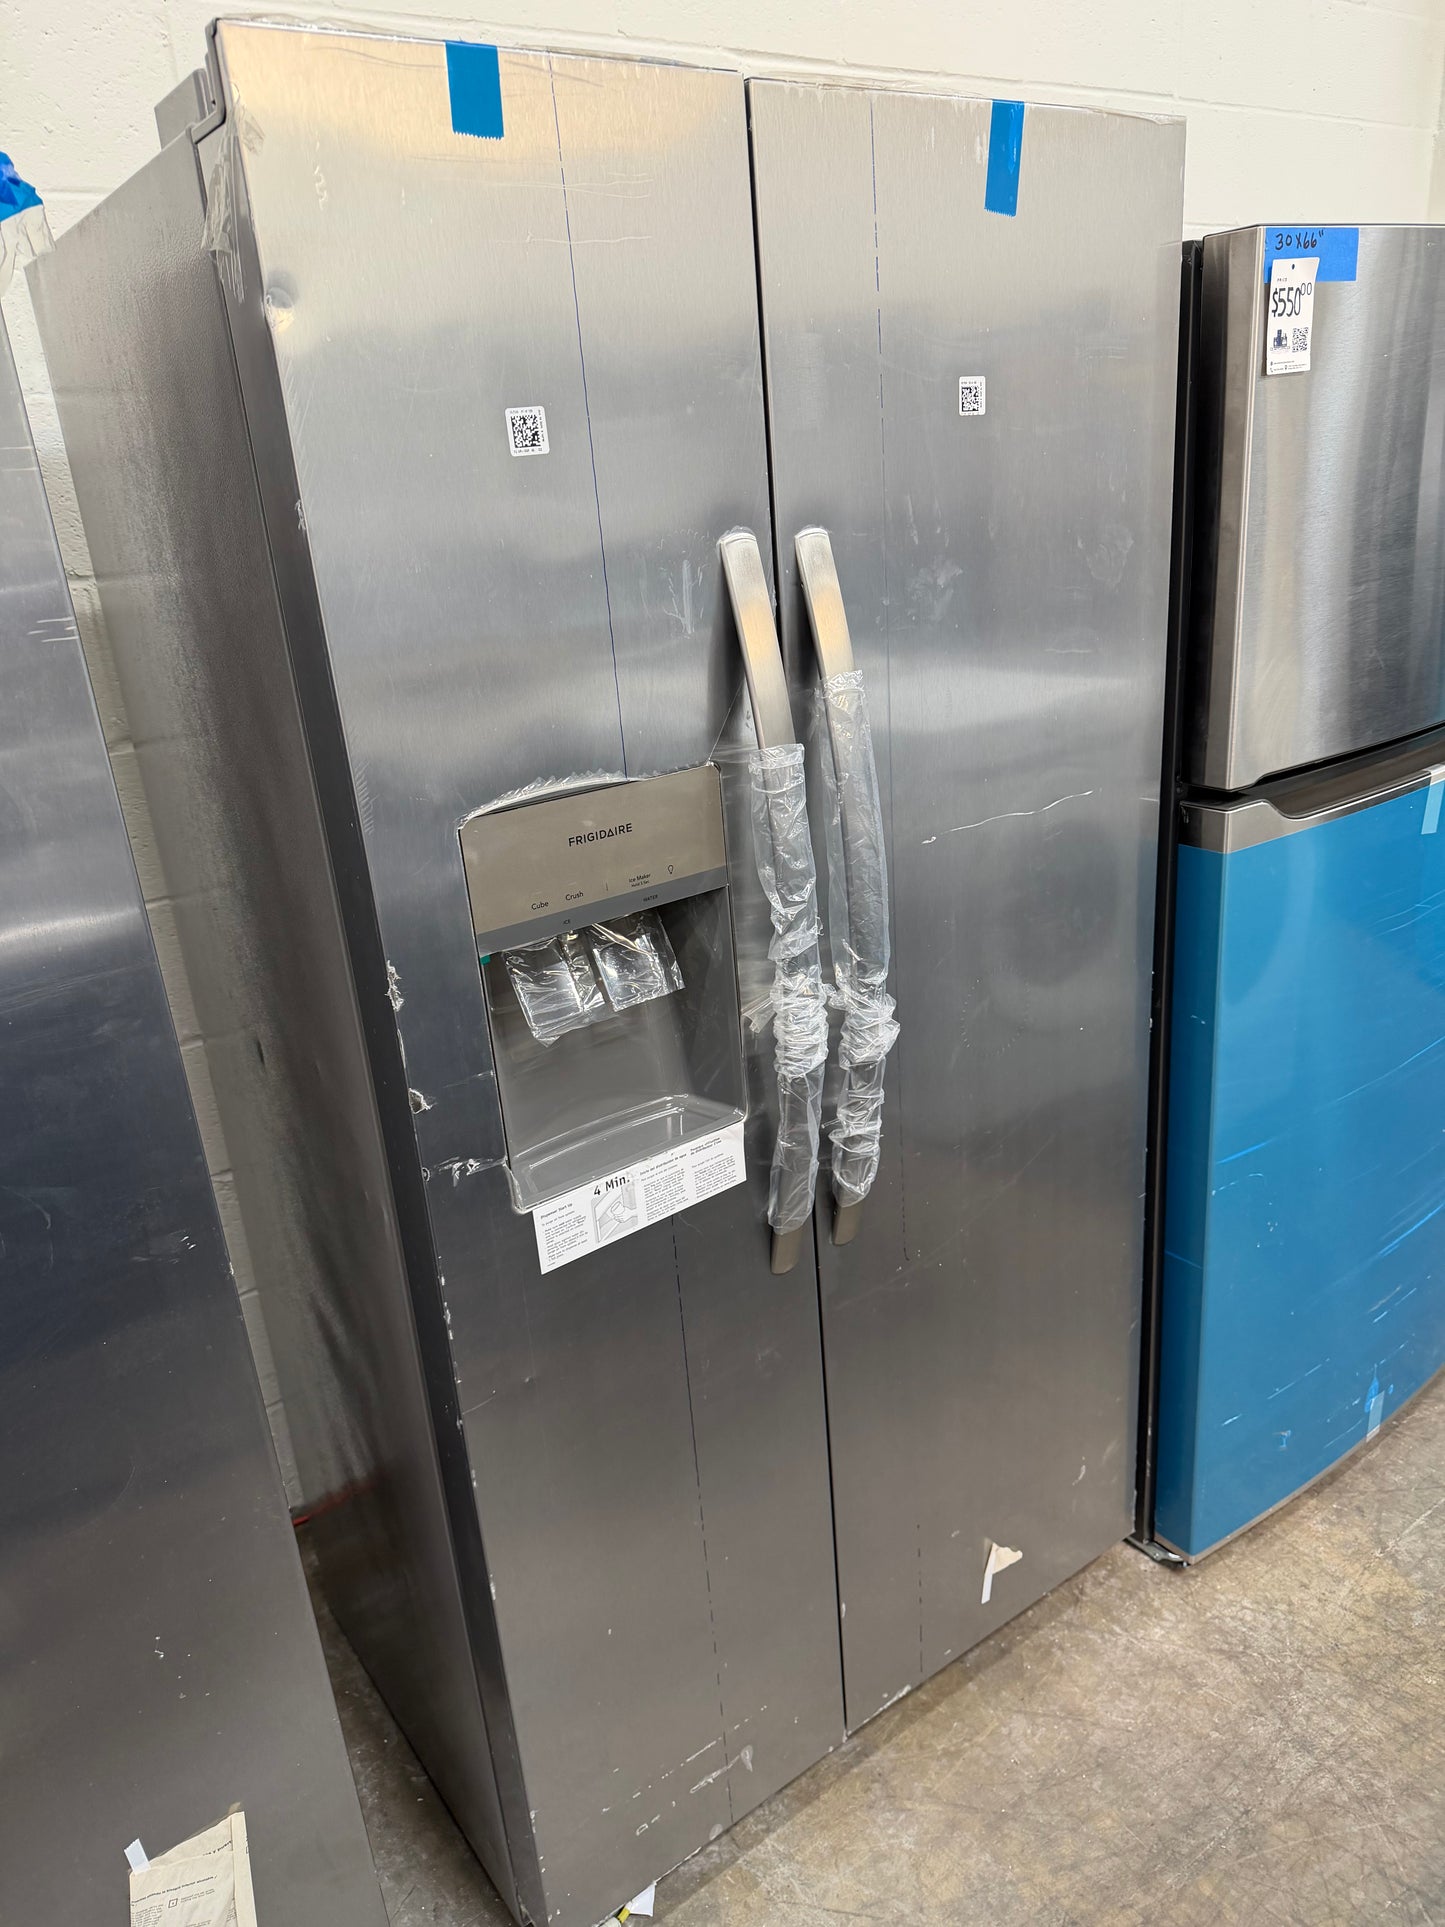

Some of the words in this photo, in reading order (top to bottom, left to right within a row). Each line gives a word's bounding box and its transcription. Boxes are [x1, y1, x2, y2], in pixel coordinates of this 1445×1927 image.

[568, 823, 633, 847] FRIGIDAIRE
[636, 873, 651, 881] Maker
[565, 890, 584, 901] Crush
[531, 901, 549, 910] Cube
[593, 1185, 601, 1195] 4
[605, 1176, 630, 1191] Min.
